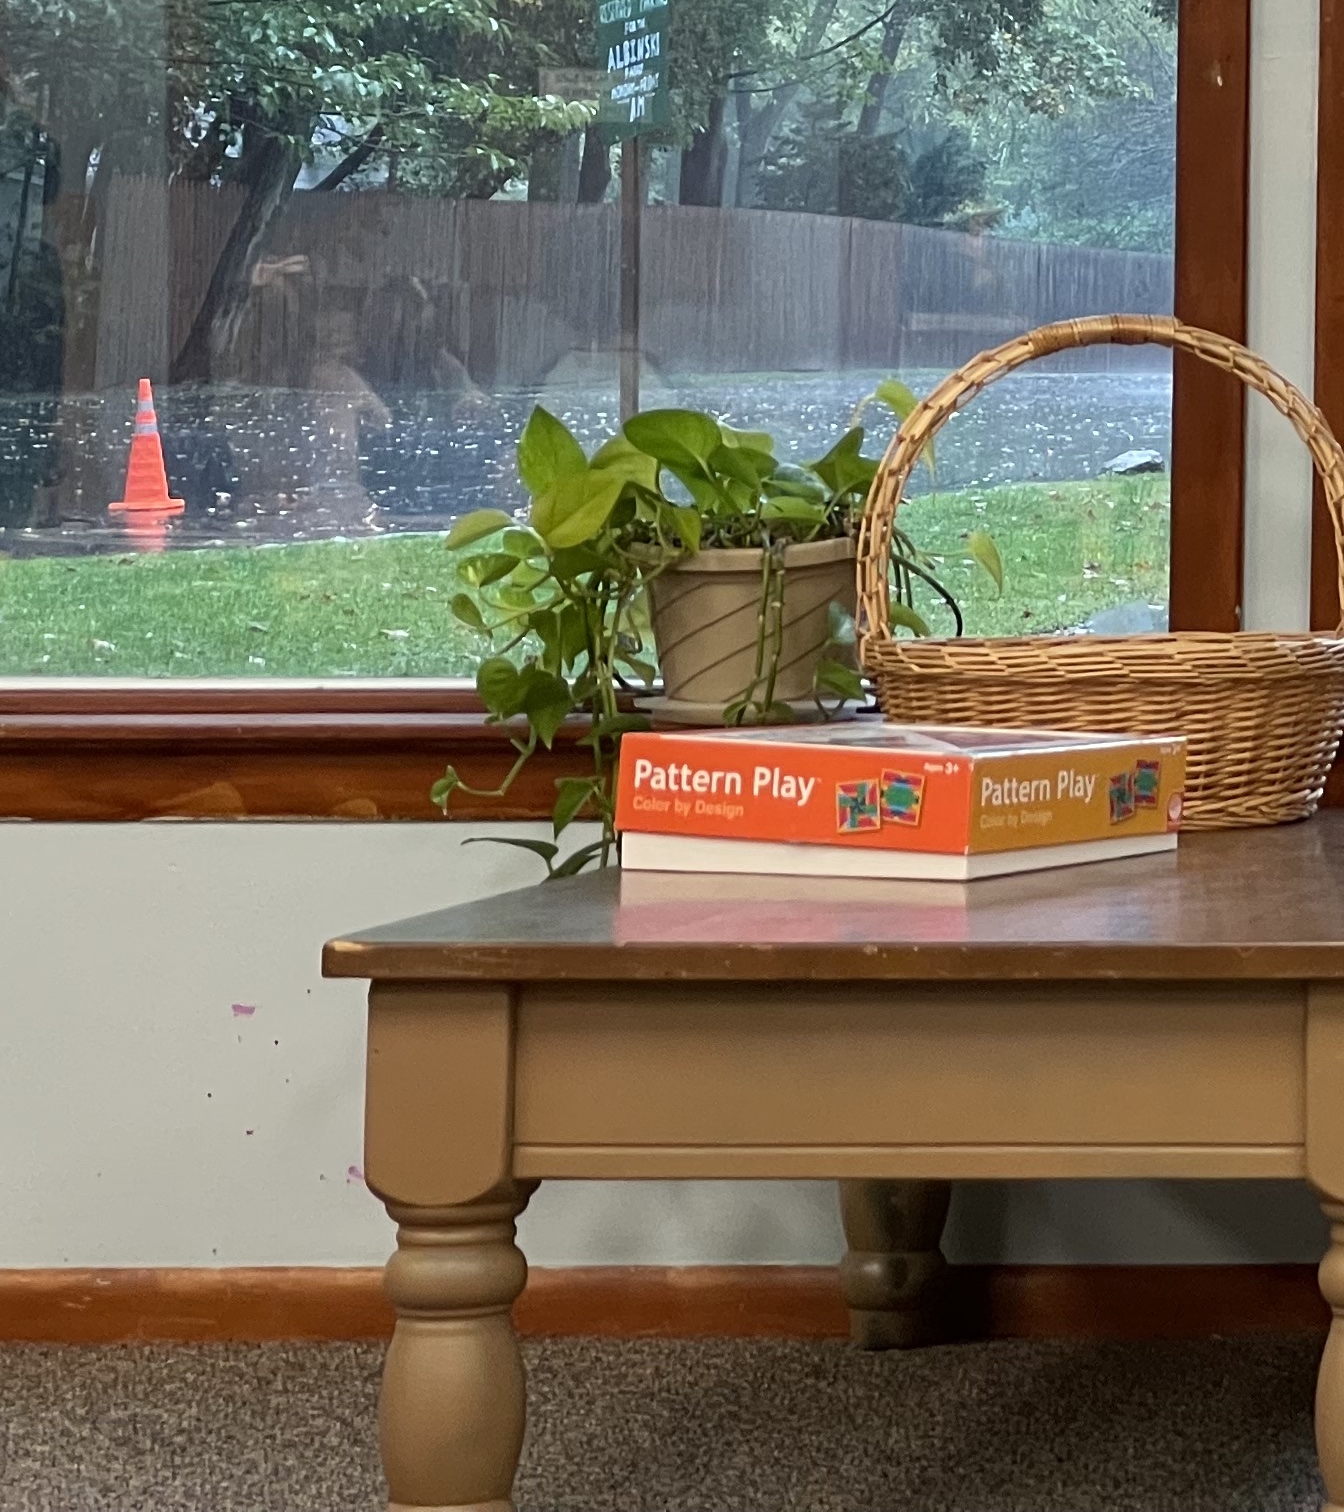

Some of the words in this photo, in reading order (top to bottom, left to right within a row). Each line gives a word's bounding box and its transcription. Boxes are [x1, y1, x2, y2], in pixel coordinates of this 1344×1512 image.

[607, 31, 660, 74] ALBINSKI
[634, 758, 742, 796] Pattern
[752, 766, 816, 807] Play
[945, 761, 959, 775] 3+
[981, 776, 1051, 807] Pattern
[1056, 769, 1096, 804] Play
[632, 796, 670, 813] Color
[674, 798, 691, 817] by
[695, 800, 744, 820] Design
[979, 813, 1006, 829] Color
[1020, 809, 1053, 826] Design
